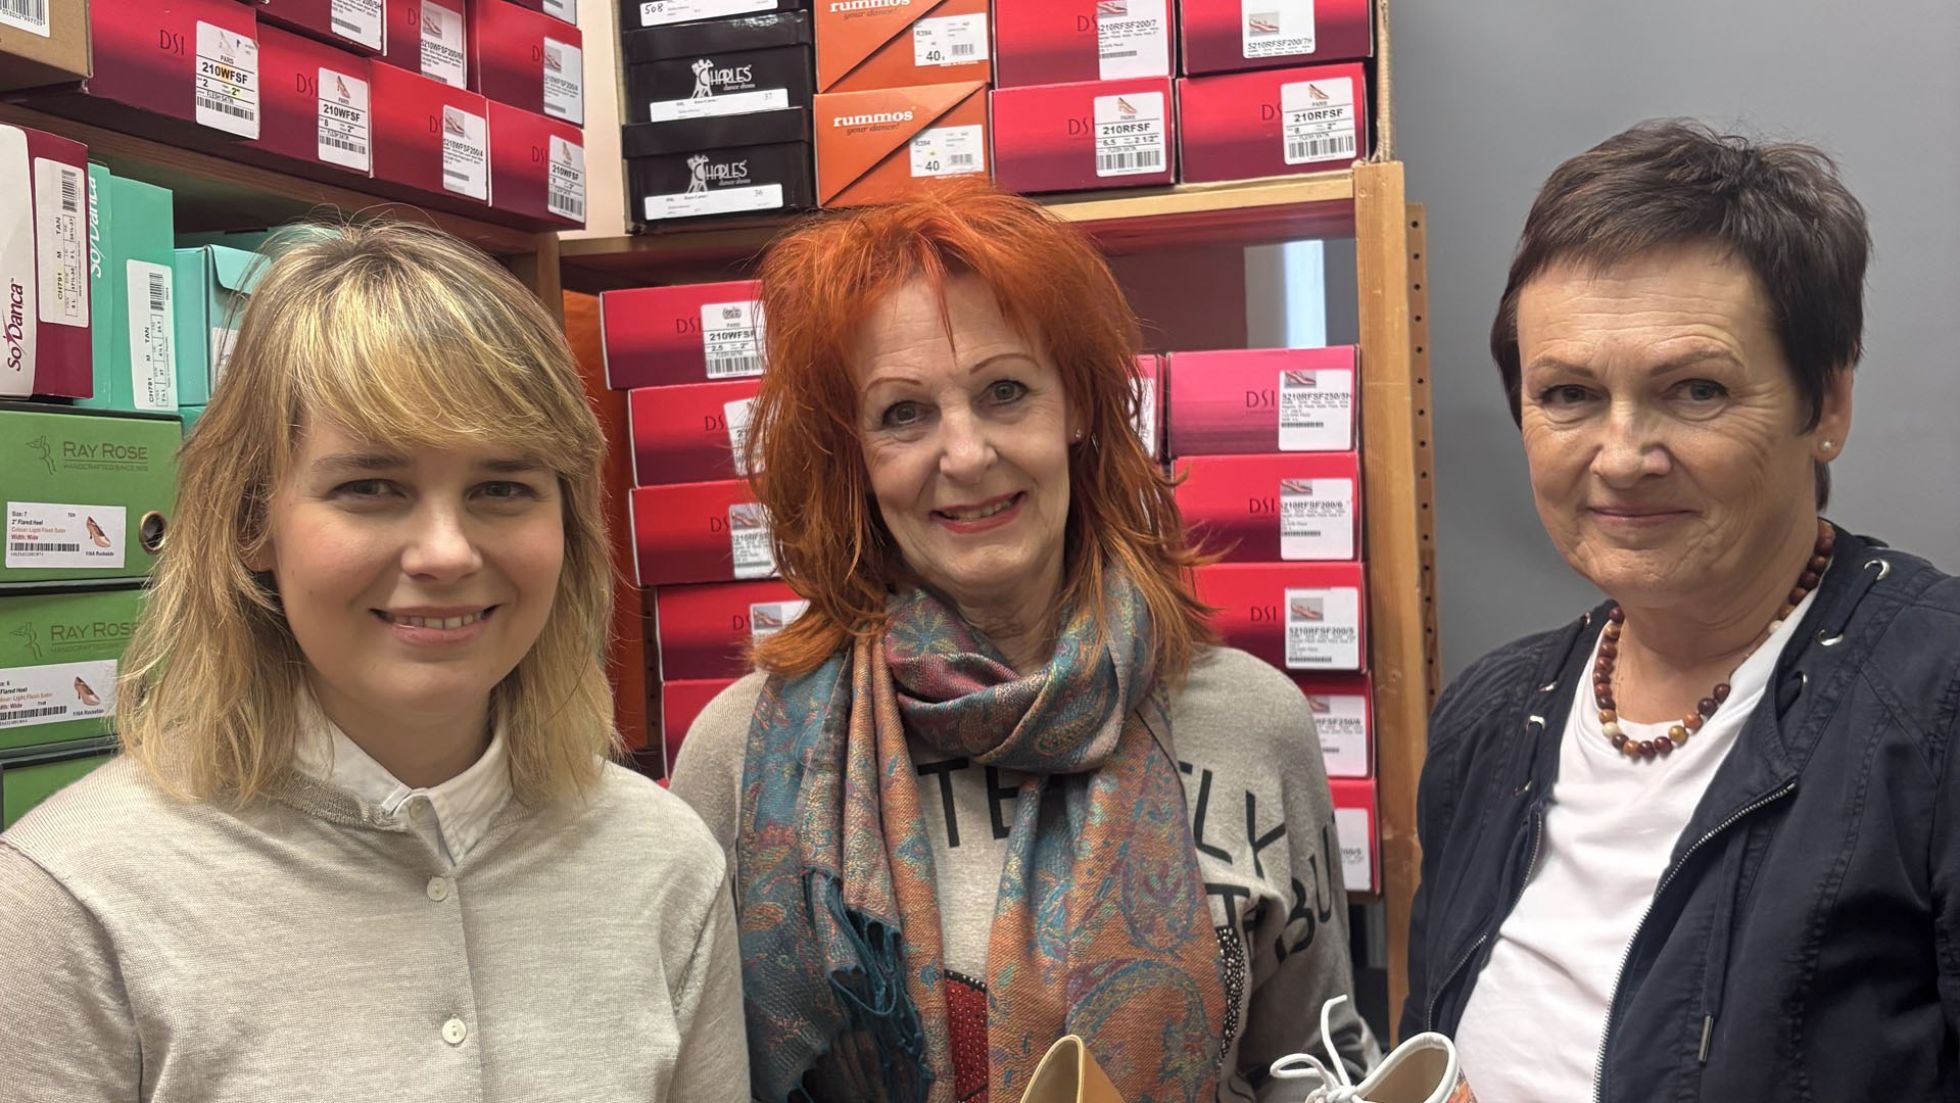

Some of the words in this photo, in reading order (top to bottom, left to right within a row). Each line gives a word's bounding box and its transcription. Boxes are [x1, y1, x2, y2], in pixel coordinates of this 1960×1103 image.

[644, 3, 664, 15] 508
[830, 0, 910, 13] rummos
[160, 29, 185, 56] DSI
[925, 49, 942, 62] 40
[202, 61, 249, 85] 210WFSF
[323, 103, 361, 123] 210WFSF
[833, 110, 914, 128] rummos
[1293, 107, 1344, 123] 210RFSF
[1102, 122, 1151, 136] 210RFSF
[925, 159, 941, 172] 40
[1246, 390, 1275, 408] DSI
[63, 440, 99, 459] RAY
[101, 442, 149, 460] ROSE
[1249, 497, 1275, 514] DSI
[1250, 606, 1277, 622] DSI
[51, 624, 89, 641] RAY
